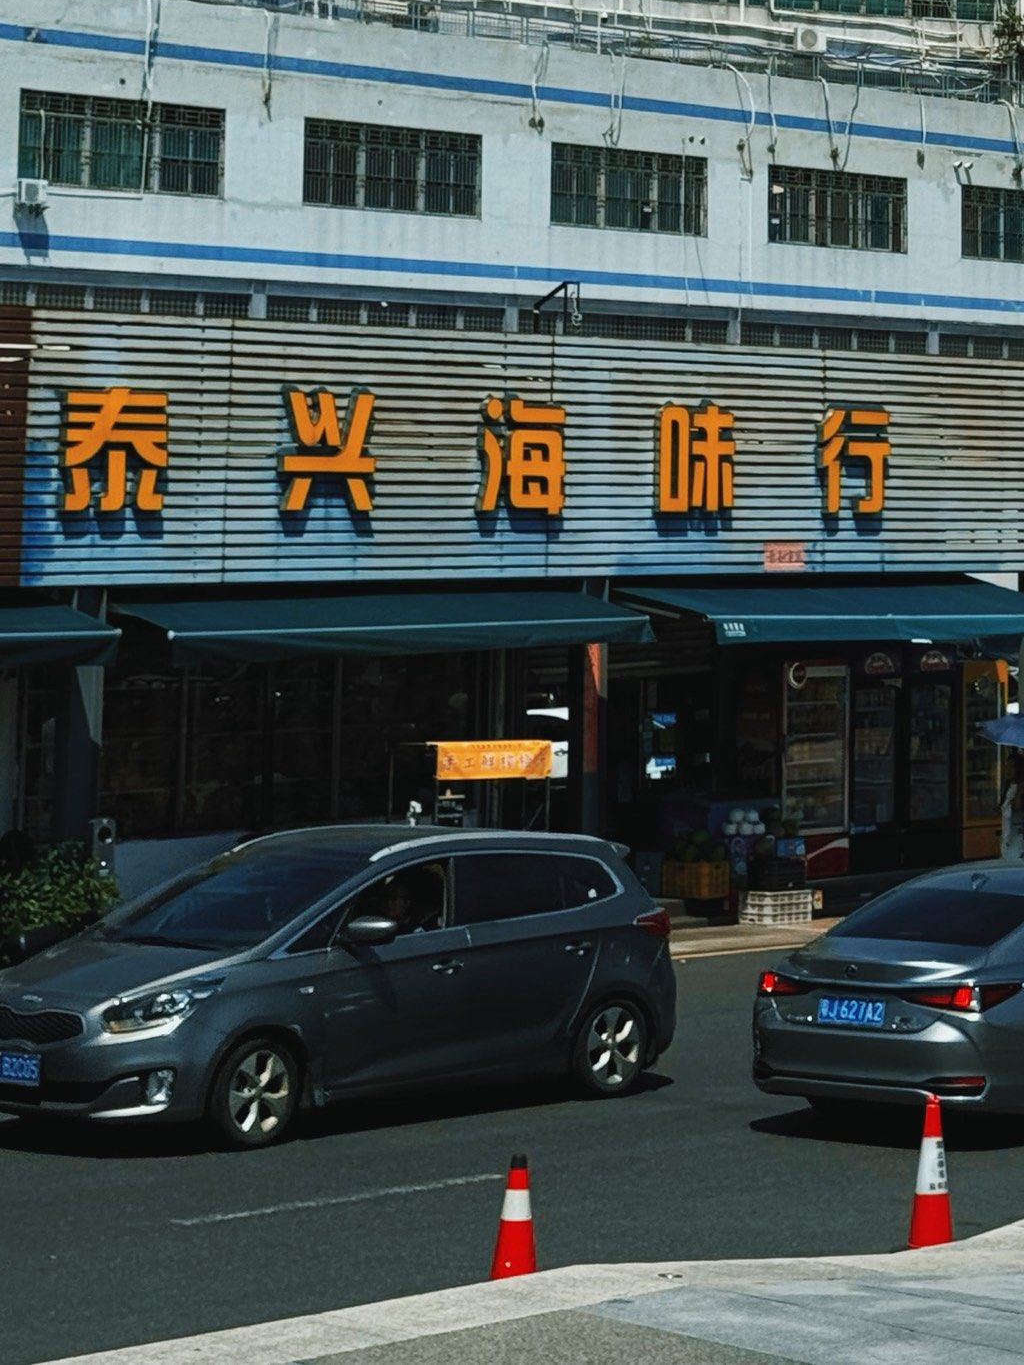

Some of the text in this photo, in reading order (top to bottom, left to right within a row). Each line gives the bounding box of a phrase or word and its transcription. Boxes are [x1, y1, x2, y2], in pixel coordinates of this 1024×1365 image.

[63, 387, 892, 516] 泰兴海味行
